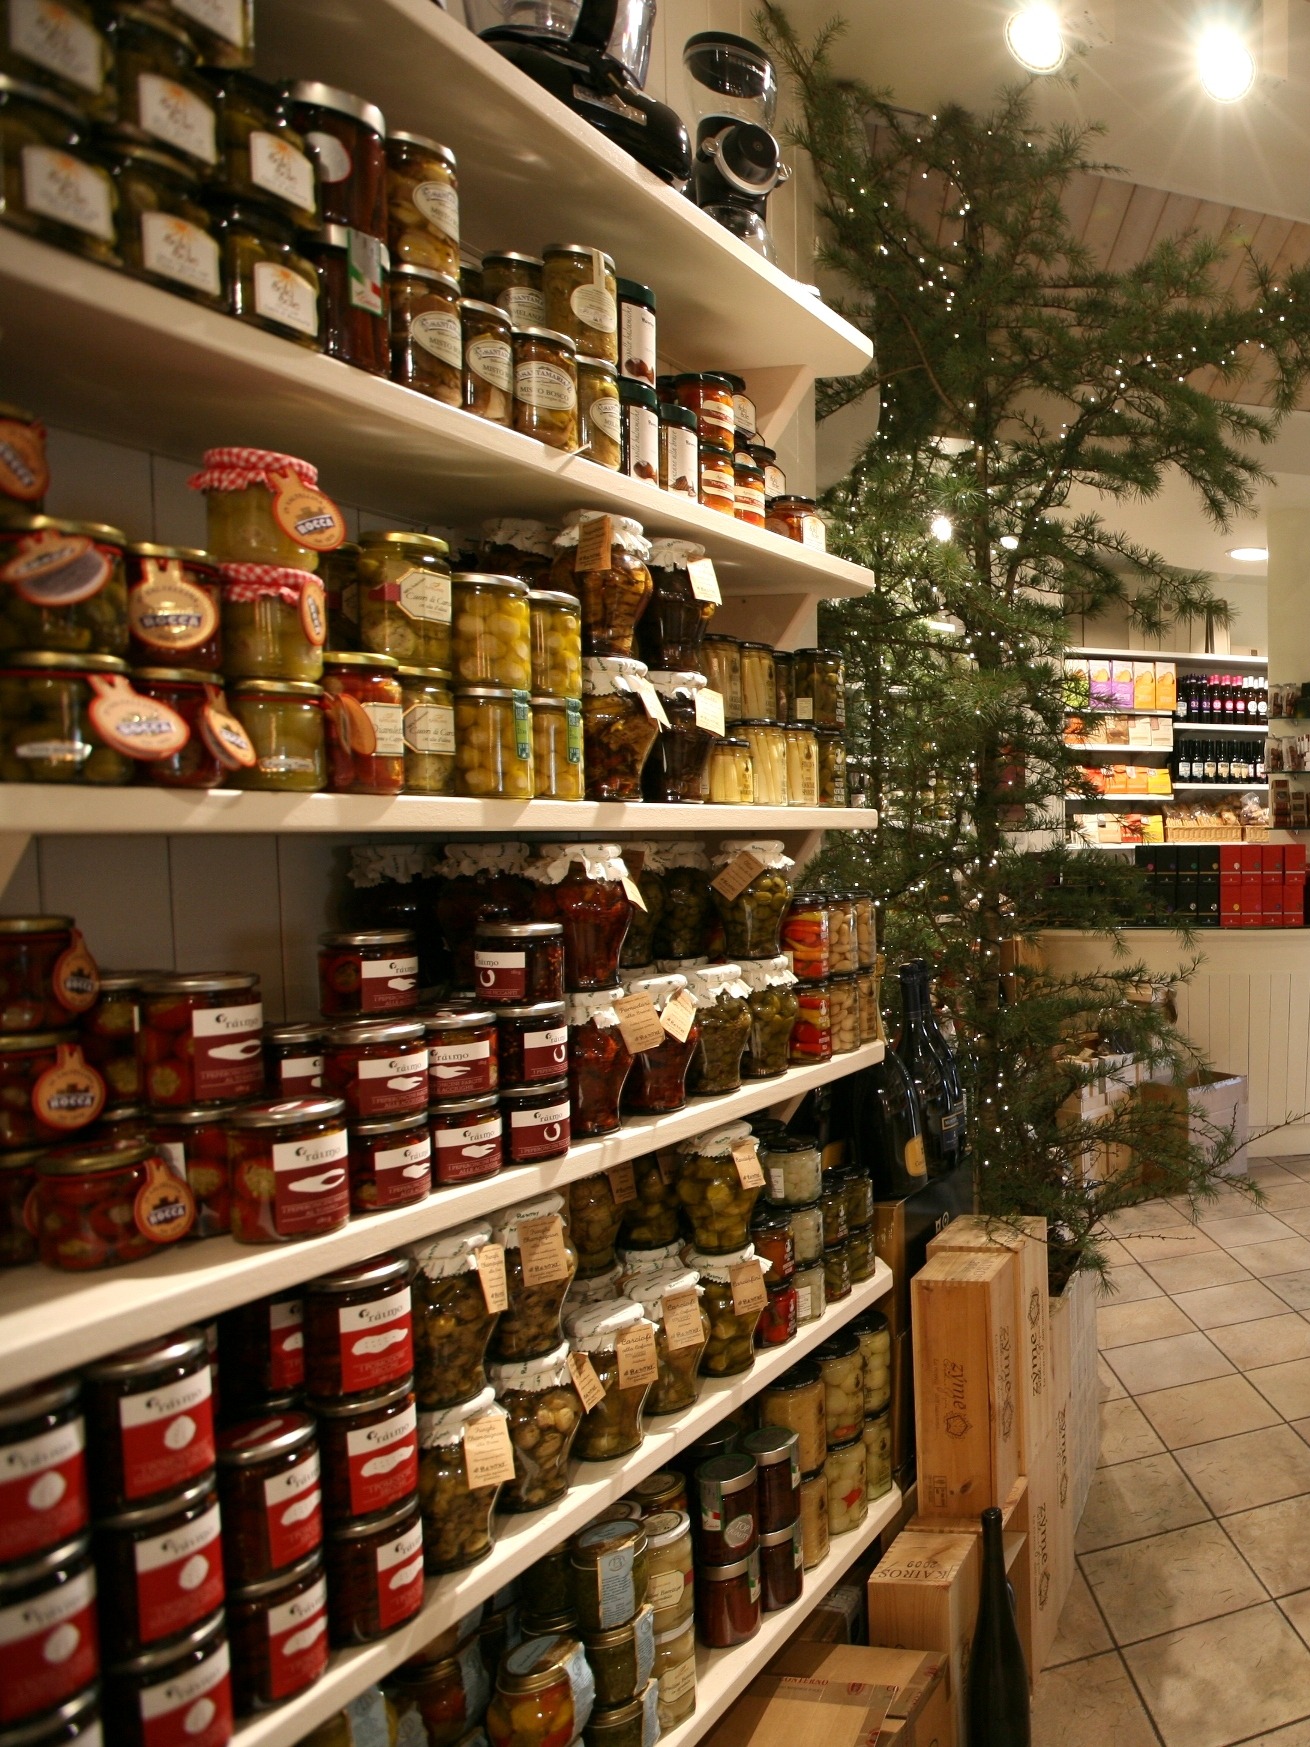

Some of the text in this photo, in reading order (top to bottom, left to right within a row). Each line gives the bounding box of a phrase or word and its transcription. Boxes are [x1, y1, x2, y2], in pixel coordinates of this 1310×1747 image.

[296, 516, 335, 535] ROCCA
[735, 1521, 751, 1532] TOP
[906, 1560, 938, 1569] 2009
[879, 1568, 950, 1580] KAIROS
